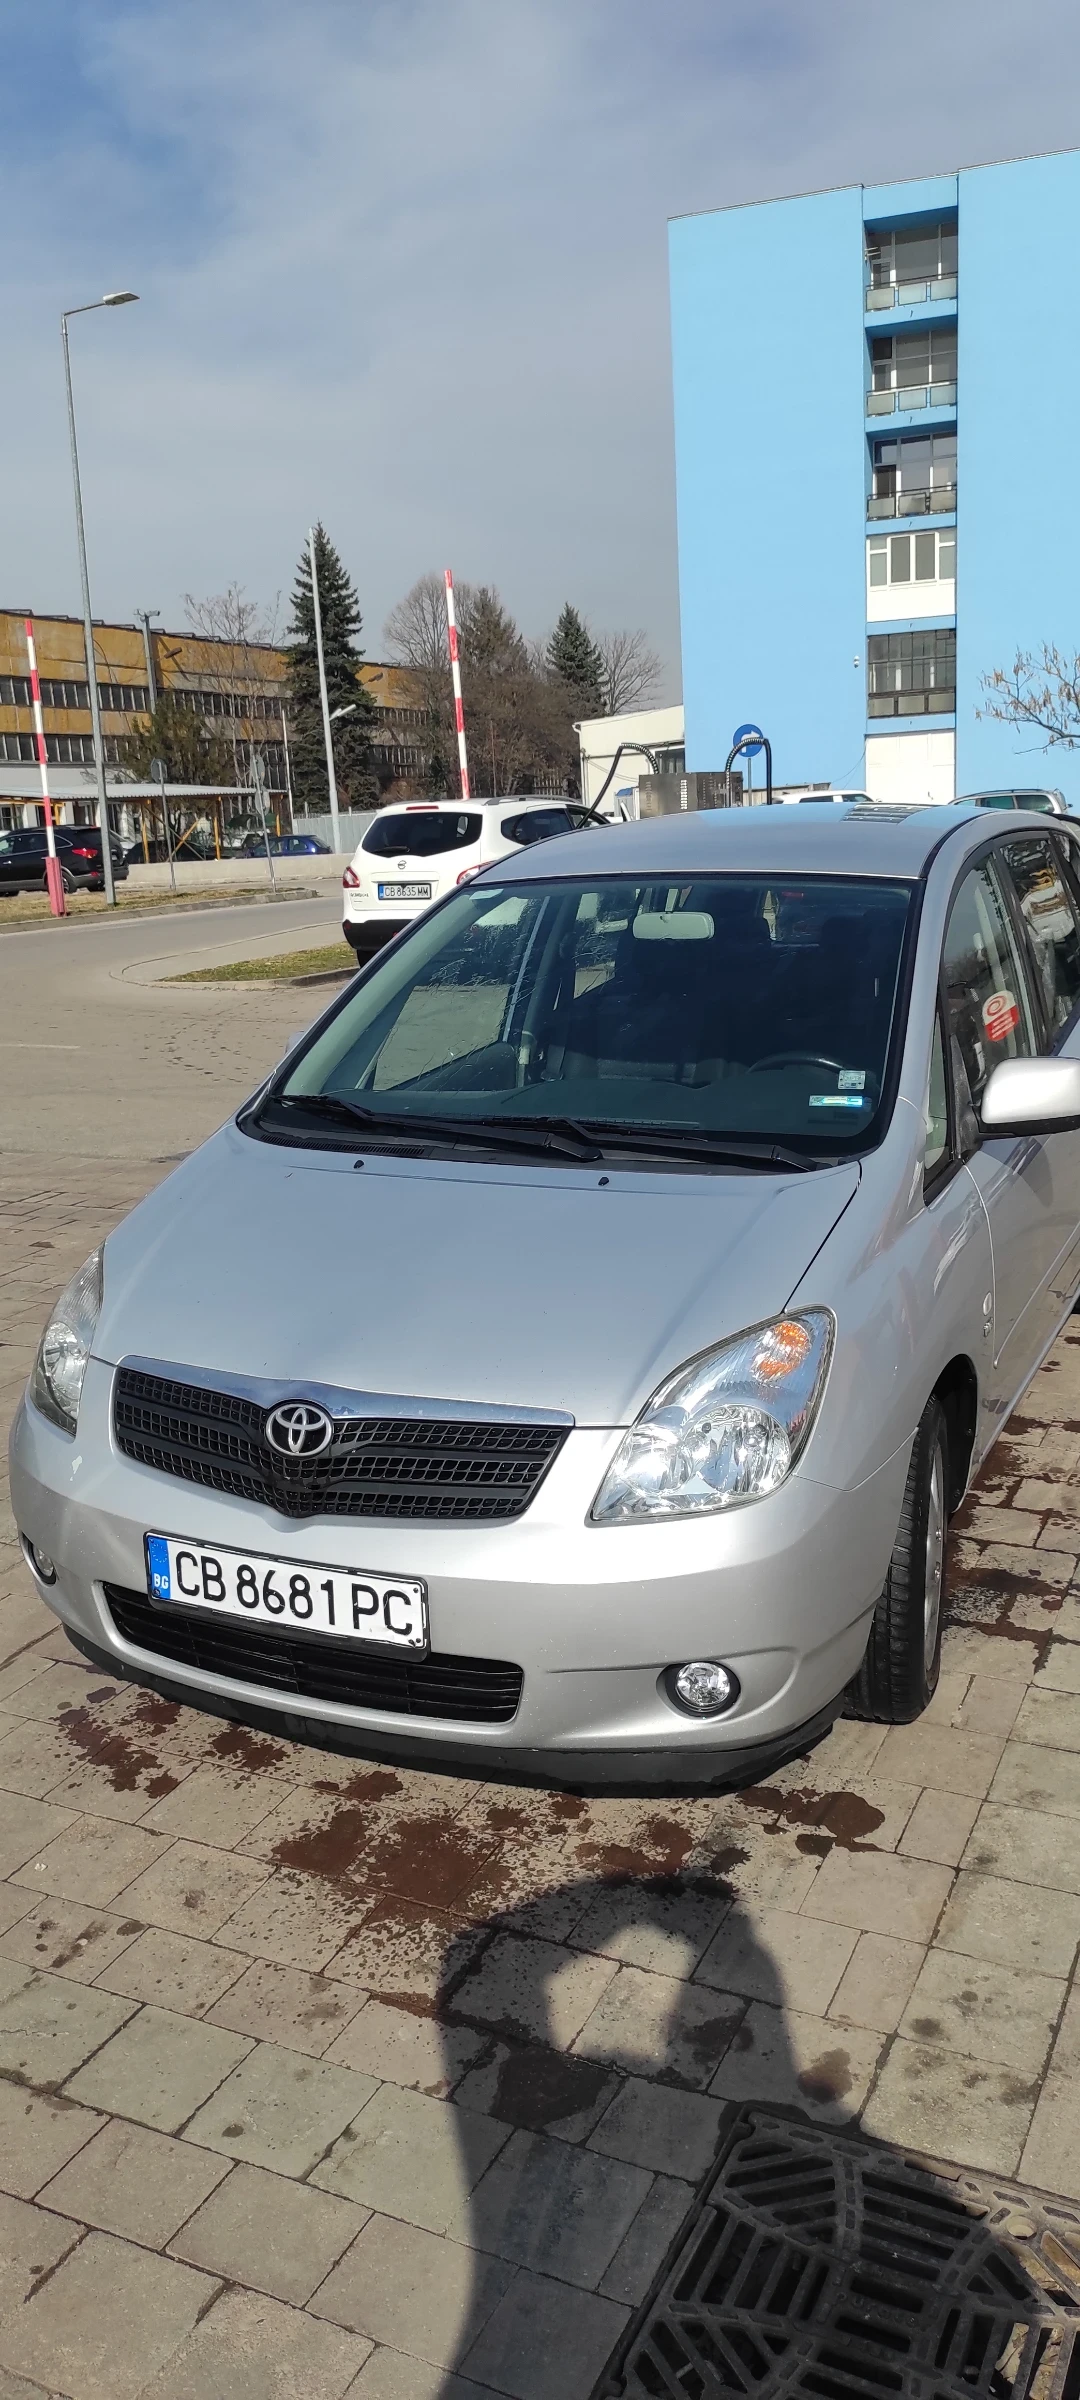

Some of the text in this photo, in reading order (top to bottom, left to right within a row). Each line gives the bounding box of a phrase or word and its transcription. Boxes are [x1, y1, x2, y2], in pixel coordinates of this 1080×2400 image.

[153, 1573, 169, 1589] BG
[175, 1550, 413, 1636] CB 8681 PC
